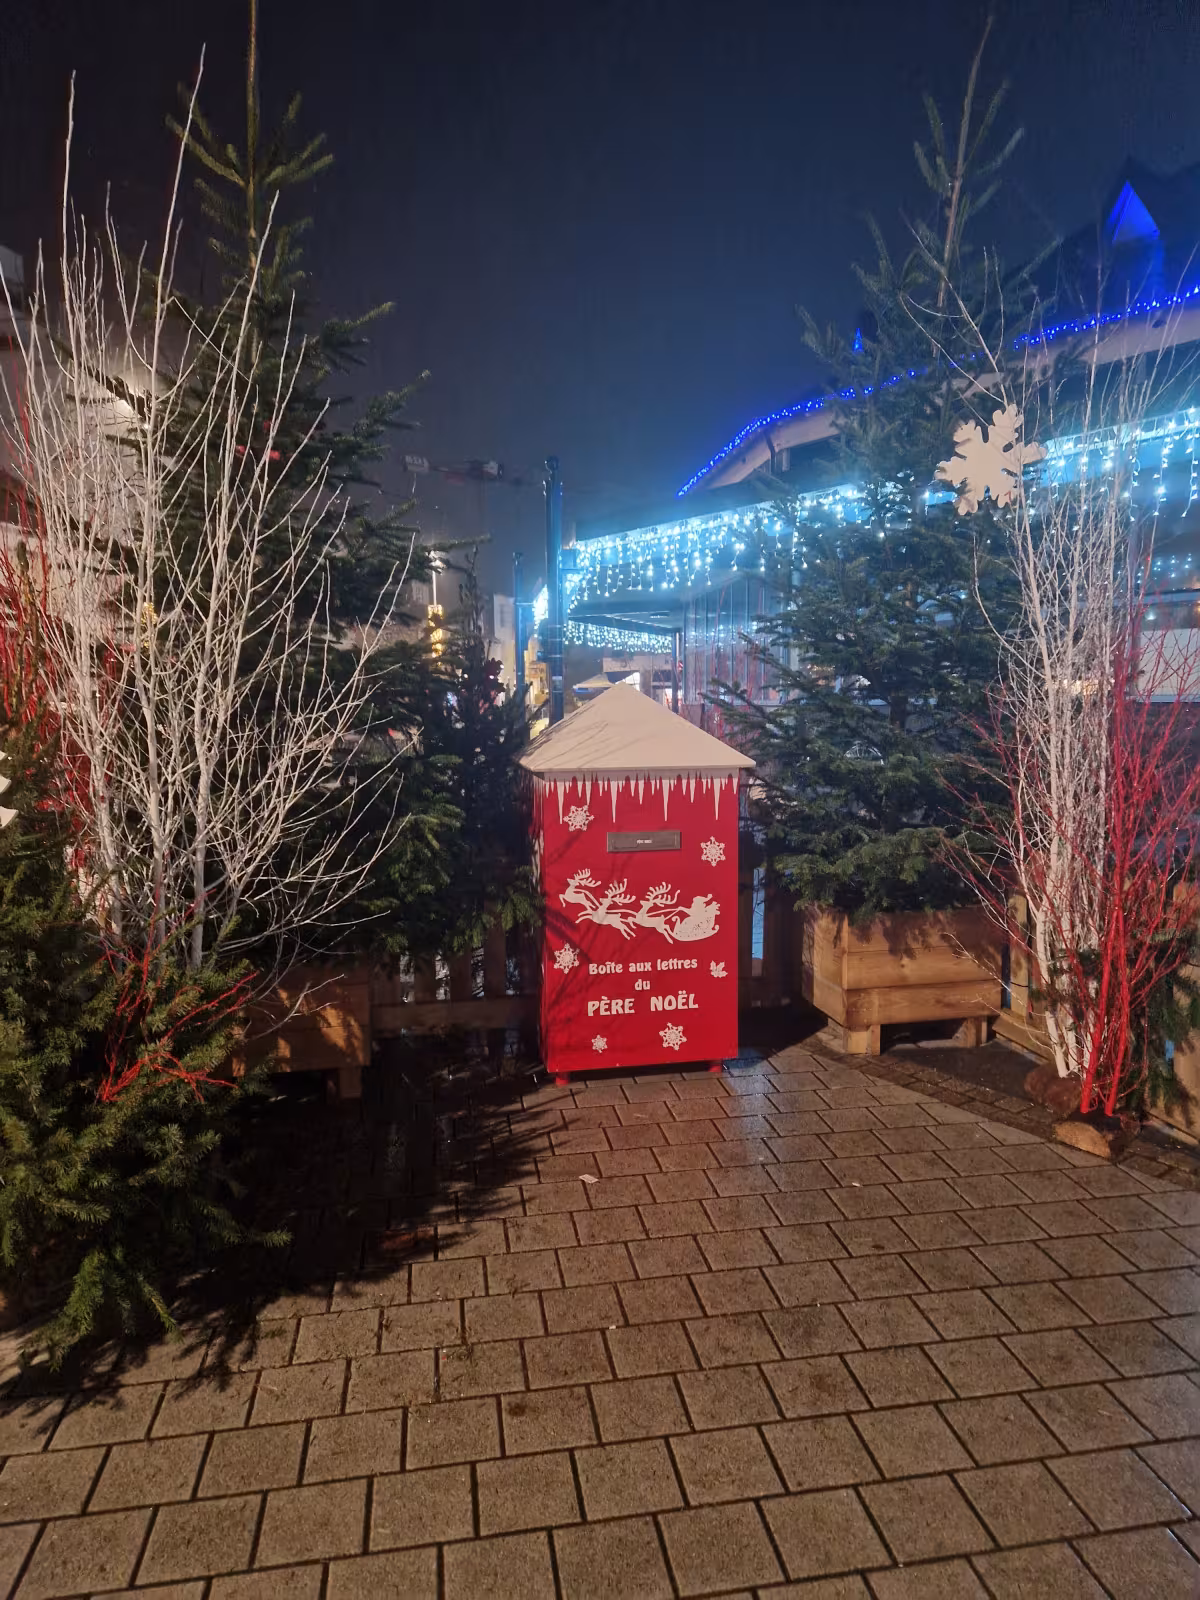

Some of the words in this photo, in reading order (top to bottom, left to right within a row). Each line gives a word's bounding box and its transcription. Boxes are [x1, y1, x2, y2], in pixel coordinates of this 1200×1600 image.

[589, 961, 623, 975] Boîte
[629, 962, 652, 973] aux
[657, 958, 698, 971] lettres
[634, 978, 651, 991] du
[587, 995, 635, 1017] PÈRE
[650, 990, 699, 1012] NOËL
